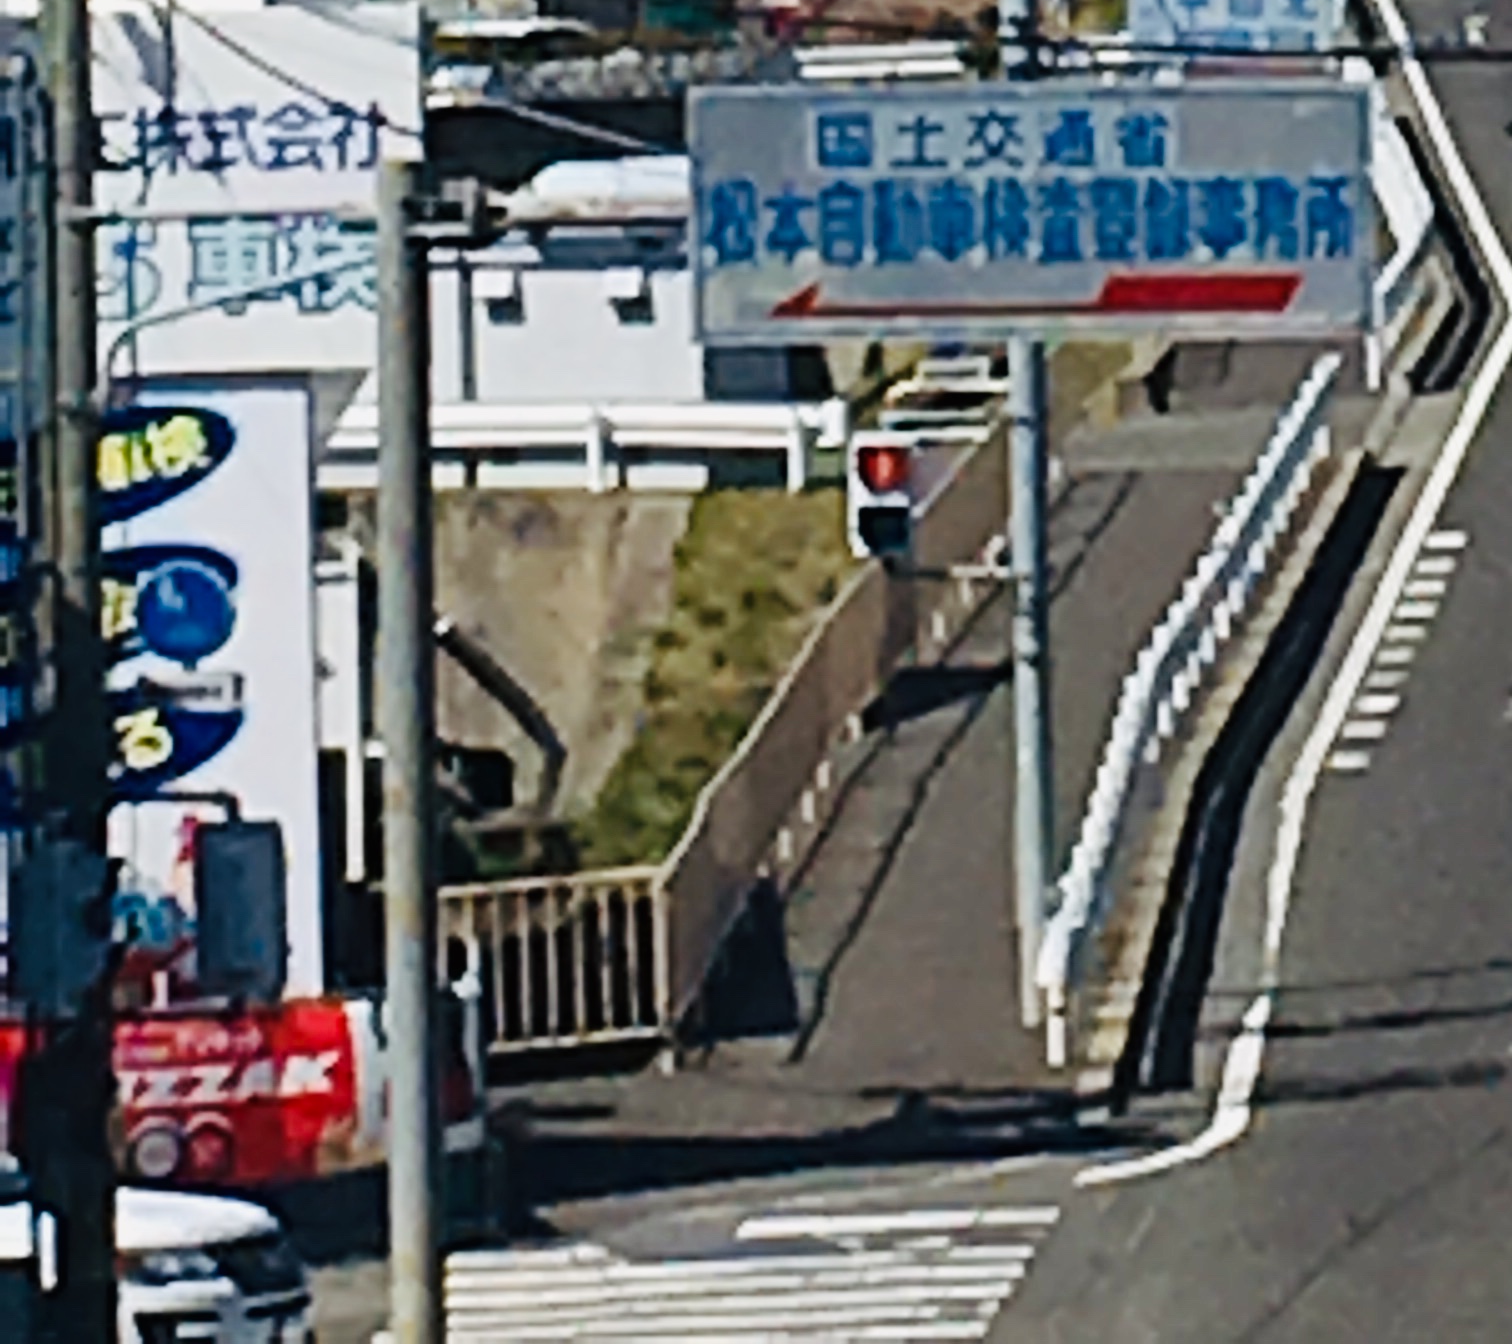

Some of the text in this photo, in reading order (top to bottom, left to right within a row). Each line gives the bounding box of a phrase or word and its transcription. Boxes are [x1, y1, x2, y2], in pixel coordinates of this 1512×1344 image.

[98, 102, 379, 174] 株式会社
[816, 108, 1169, 168] 国土交通省
